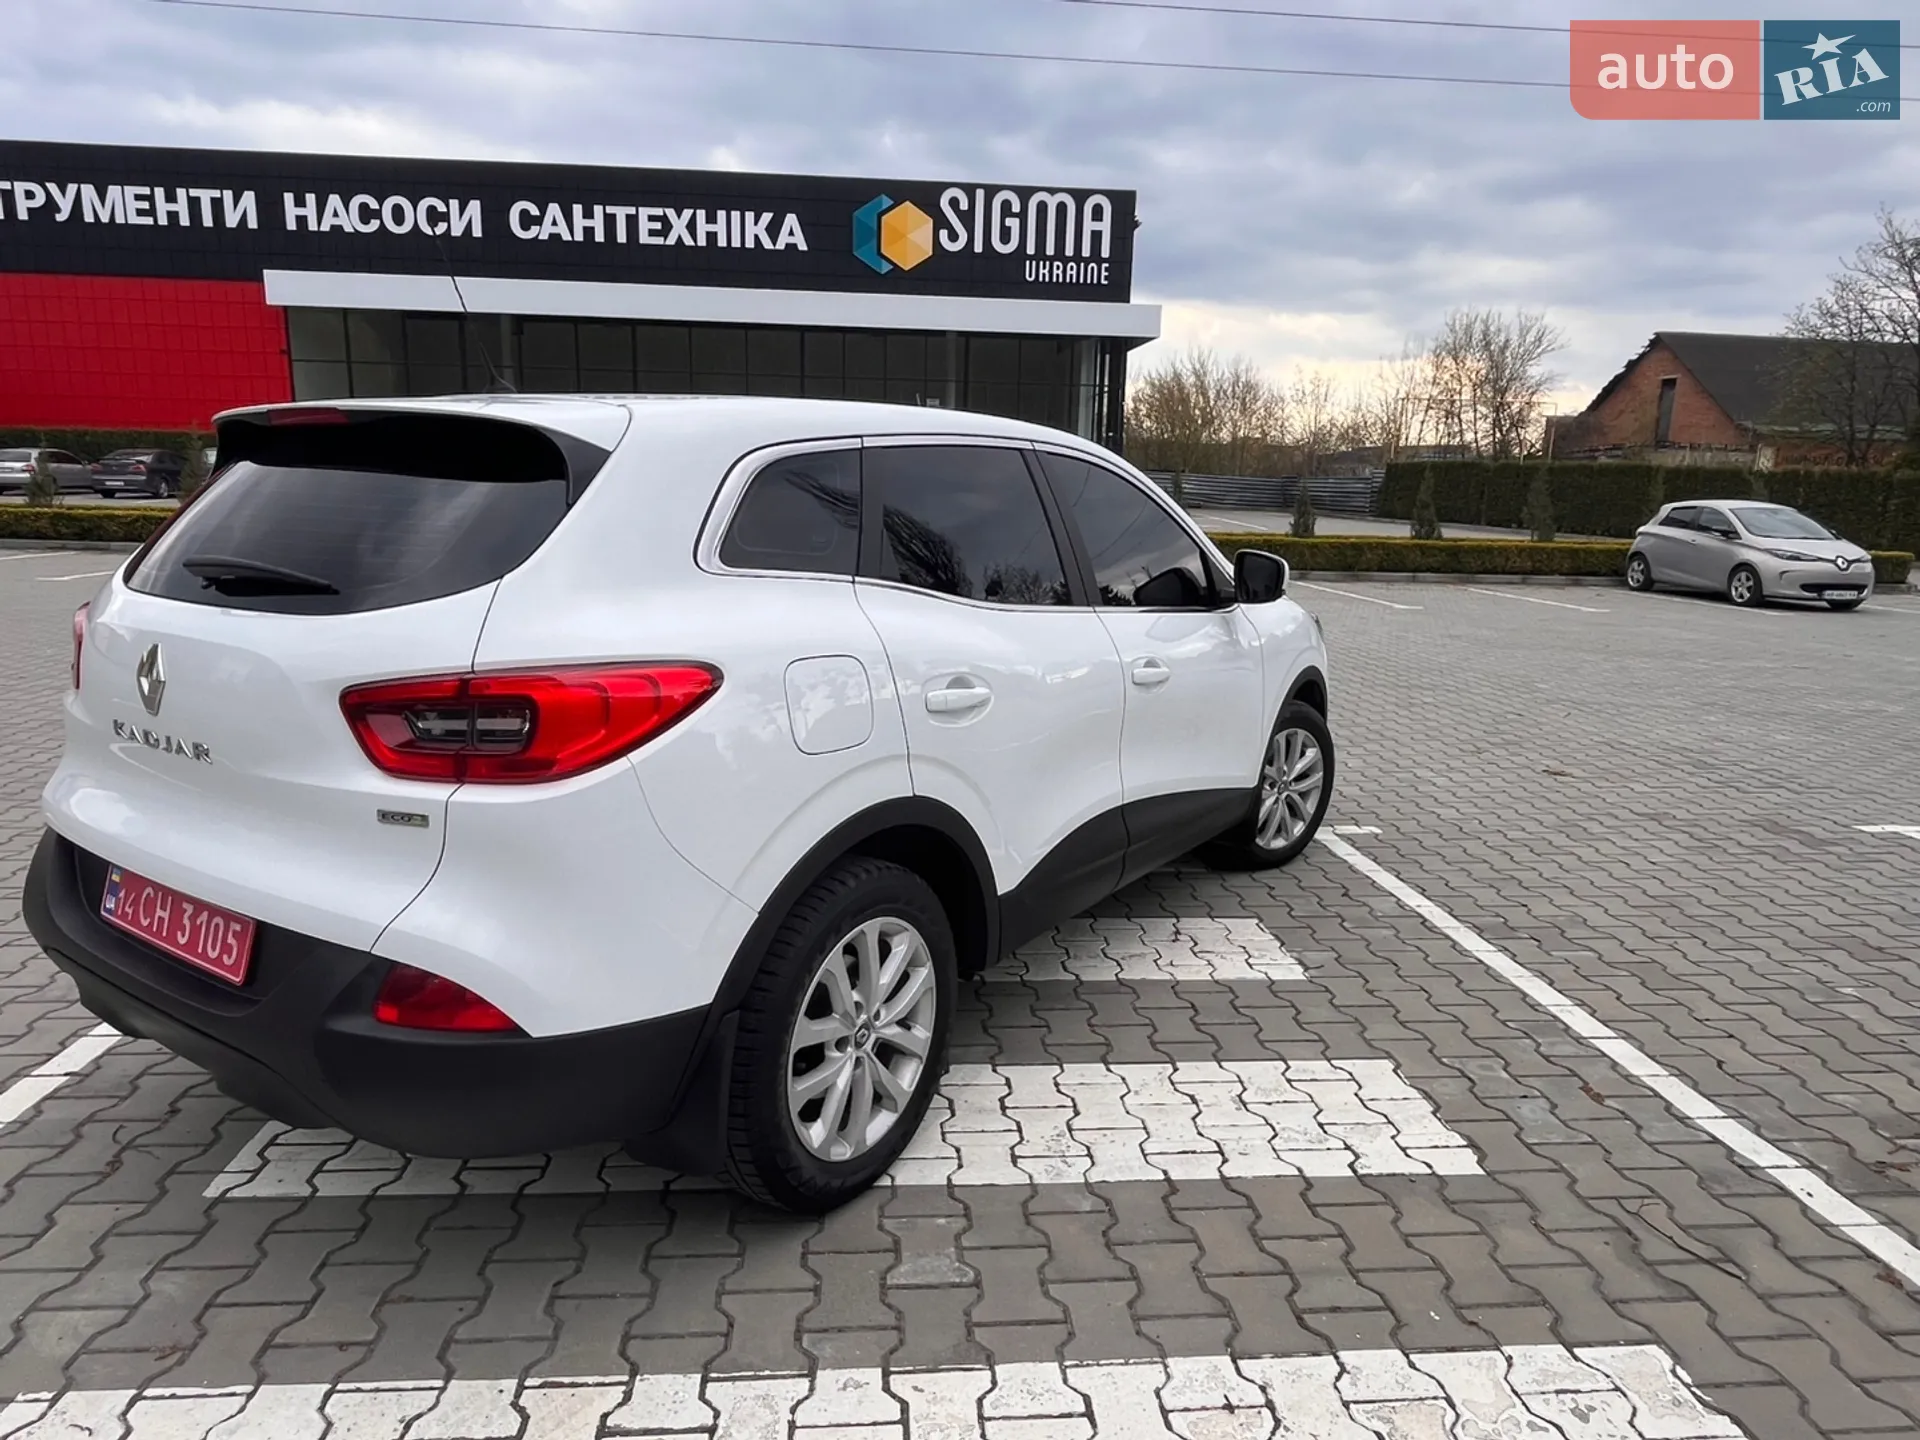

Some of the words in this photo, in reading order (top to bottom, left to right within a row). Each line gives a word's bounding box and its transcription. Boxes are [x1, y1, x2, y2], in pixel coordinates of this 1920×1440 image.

[283, 192, 483, 238] НАСОСИ
[508, 200, 809, 252] САНТЕХНІКА
[938, 187, 1112, 259] SIGMA
[1024, 260, 1110, 286] UKRAINE
[113, 719, 213, 765] KADJAR
[117, 888, 136, 920] 14
[176, 902, 242, 966] 3105
